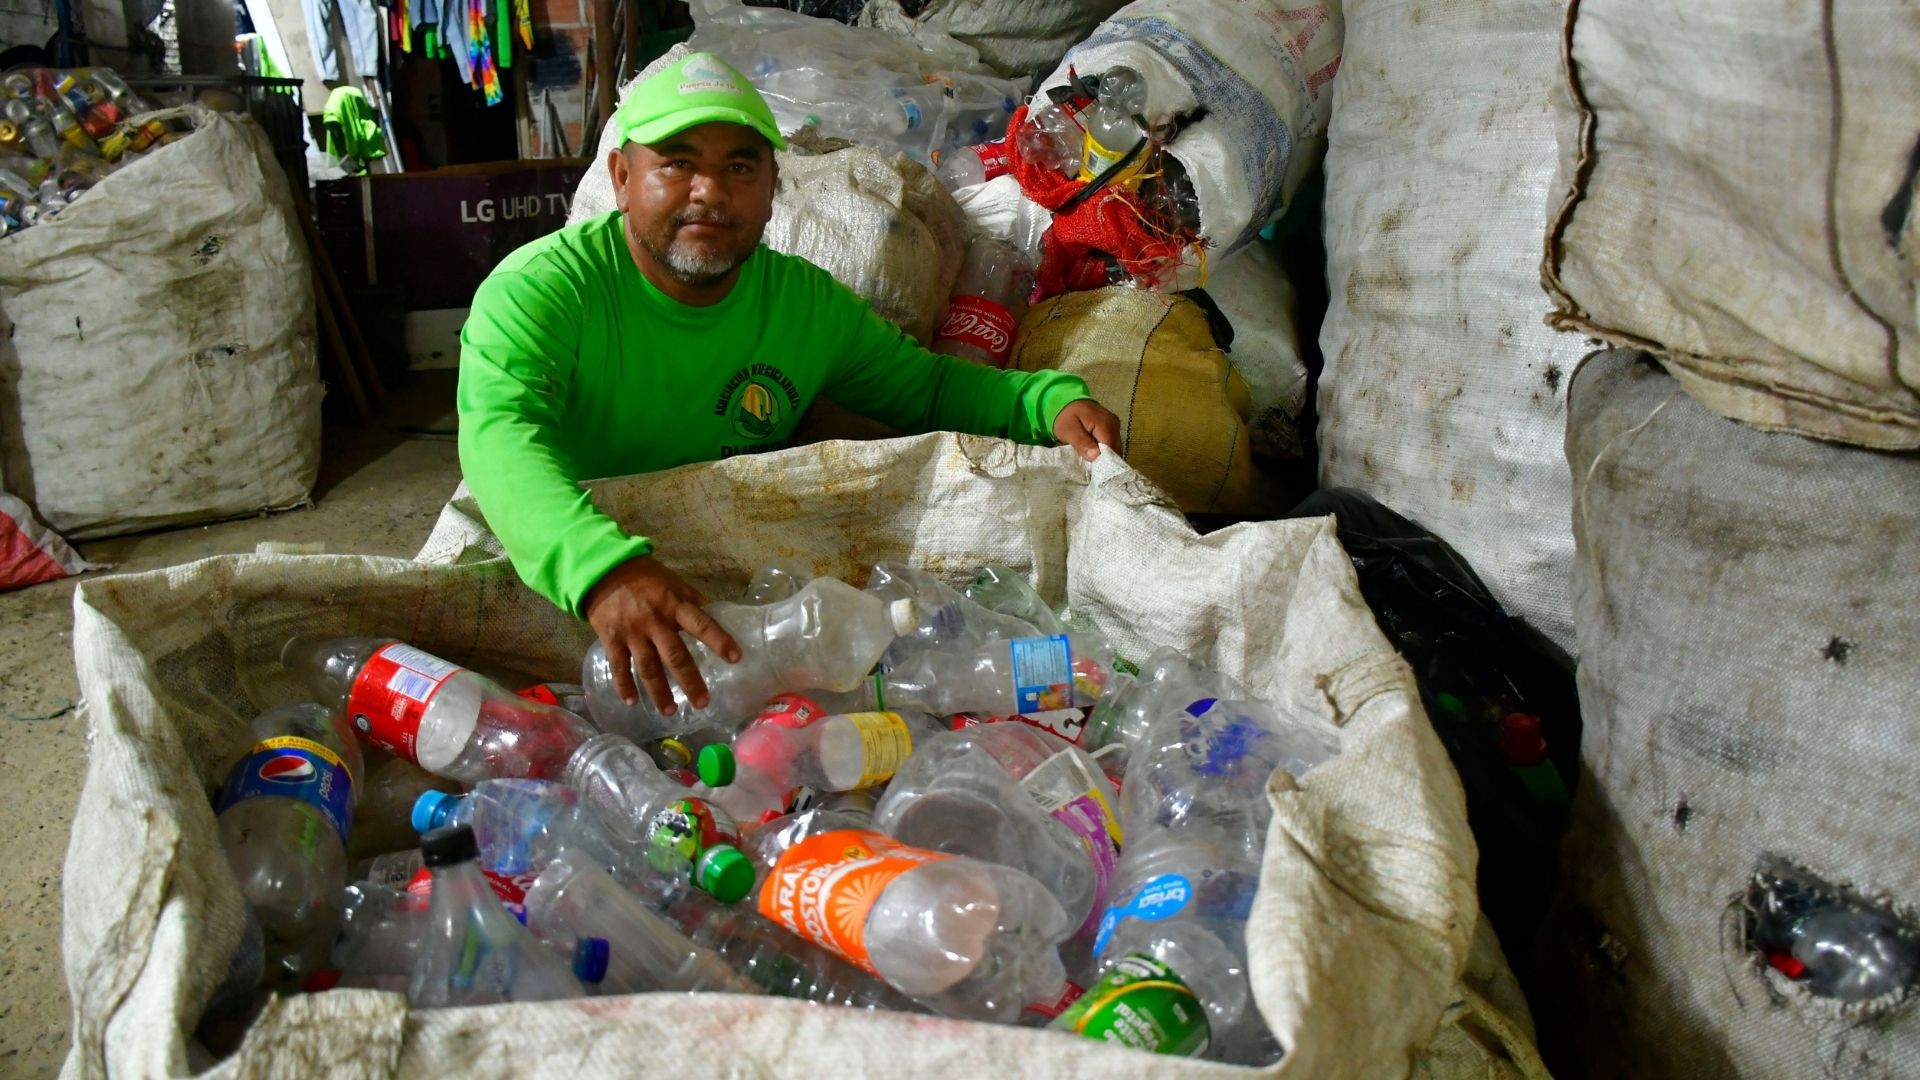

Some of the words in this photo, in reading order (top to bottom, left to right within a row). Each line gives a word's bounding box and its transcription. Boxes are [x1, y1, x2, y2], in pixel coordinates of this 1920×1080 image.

[460, 199, 496, 223] LG
[502, 195, 541, 220] UHD
[545, 192, 576, 216] TV
[1138, 888, 1185, 909] brisa
